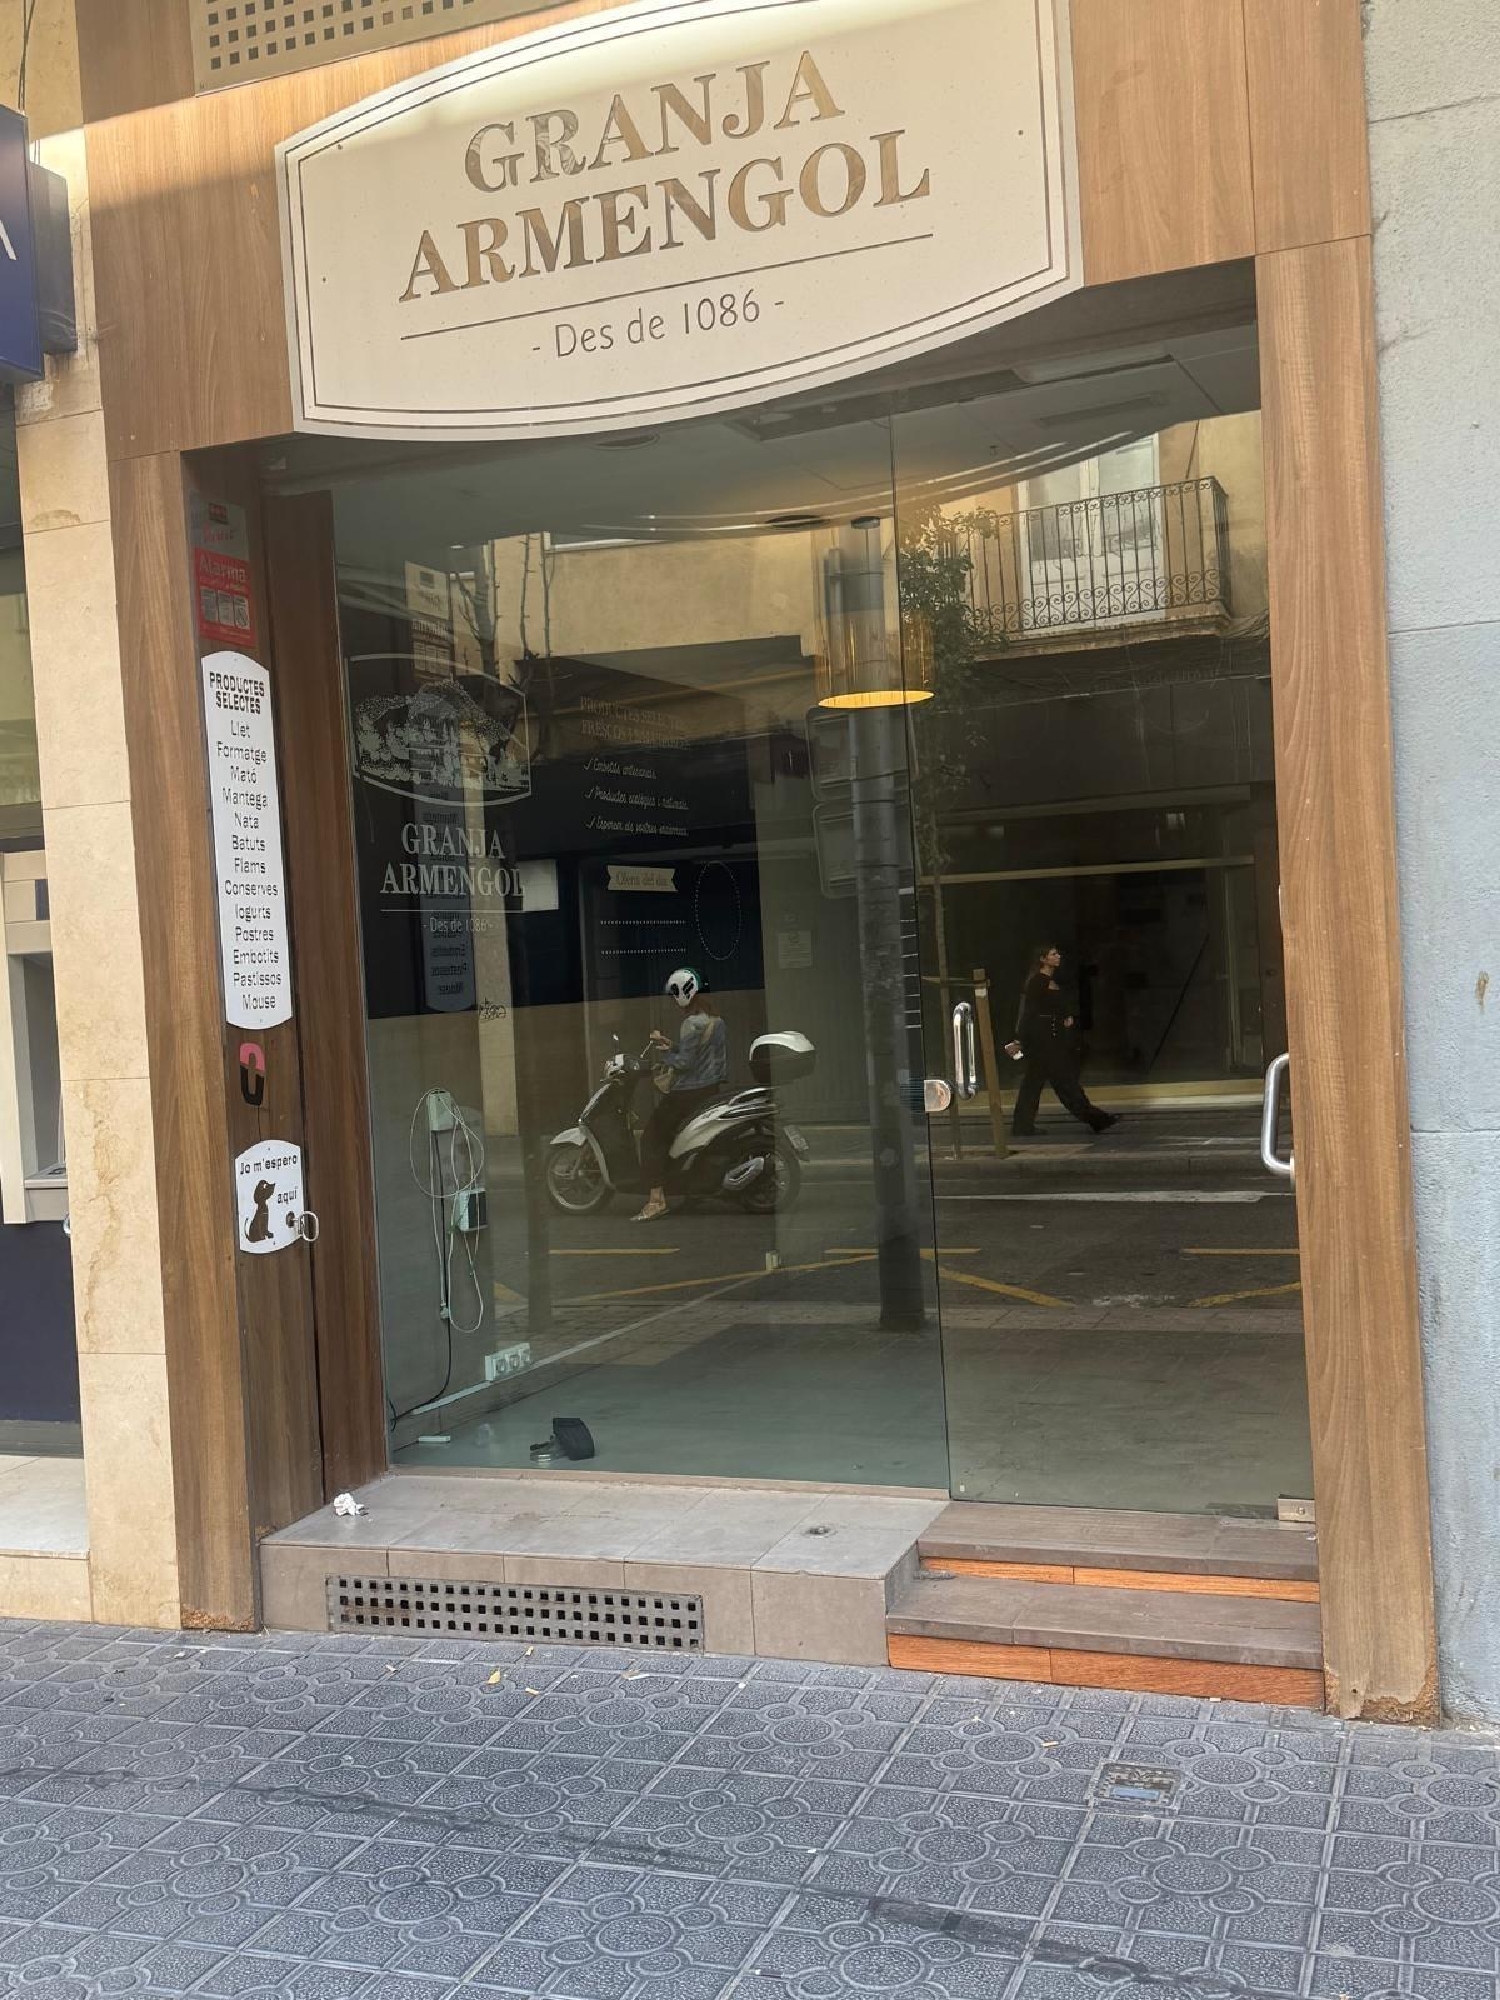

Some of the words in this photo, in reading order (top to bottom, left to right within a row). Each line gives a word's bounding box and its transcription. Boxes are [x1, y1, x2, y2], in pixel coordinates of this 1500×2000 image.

[464, 50, 845, 194] GRANJA
[397, 129, 932, 302] ARMENGOL
[554, 319, 615, 359] Des
[626, 306, 665, 346] de
[683, 290, 761, 336] 1086
[209, 671, 265, 697] PRODUCTES
[215, 691, 261, 714] SELECTES
[231, 720, 251, 738] Llet
[216, 741, 267, 765] Formatge
[222, 788, 268, 810] Mantega
[234, 813, 260, 830] Nata
[232, 834, 266, 851] Batuts
[401, 822, 505, 860] GRANJA
[234, 857, 266, 874] Flams
[380, 861, 525, 896] ARMENGOL
[225, 880, 279, 896] Conserves
[235, 903, 271, 922] Iogurts
[235, 926, 274, 942] Postres
[233, 948, 279, 964] Embotits
[233, 972, 282, 987] Pastissos
[242, 994, 277, 1010] Mouse
[253, 1155, 296, 1171] m'espero
